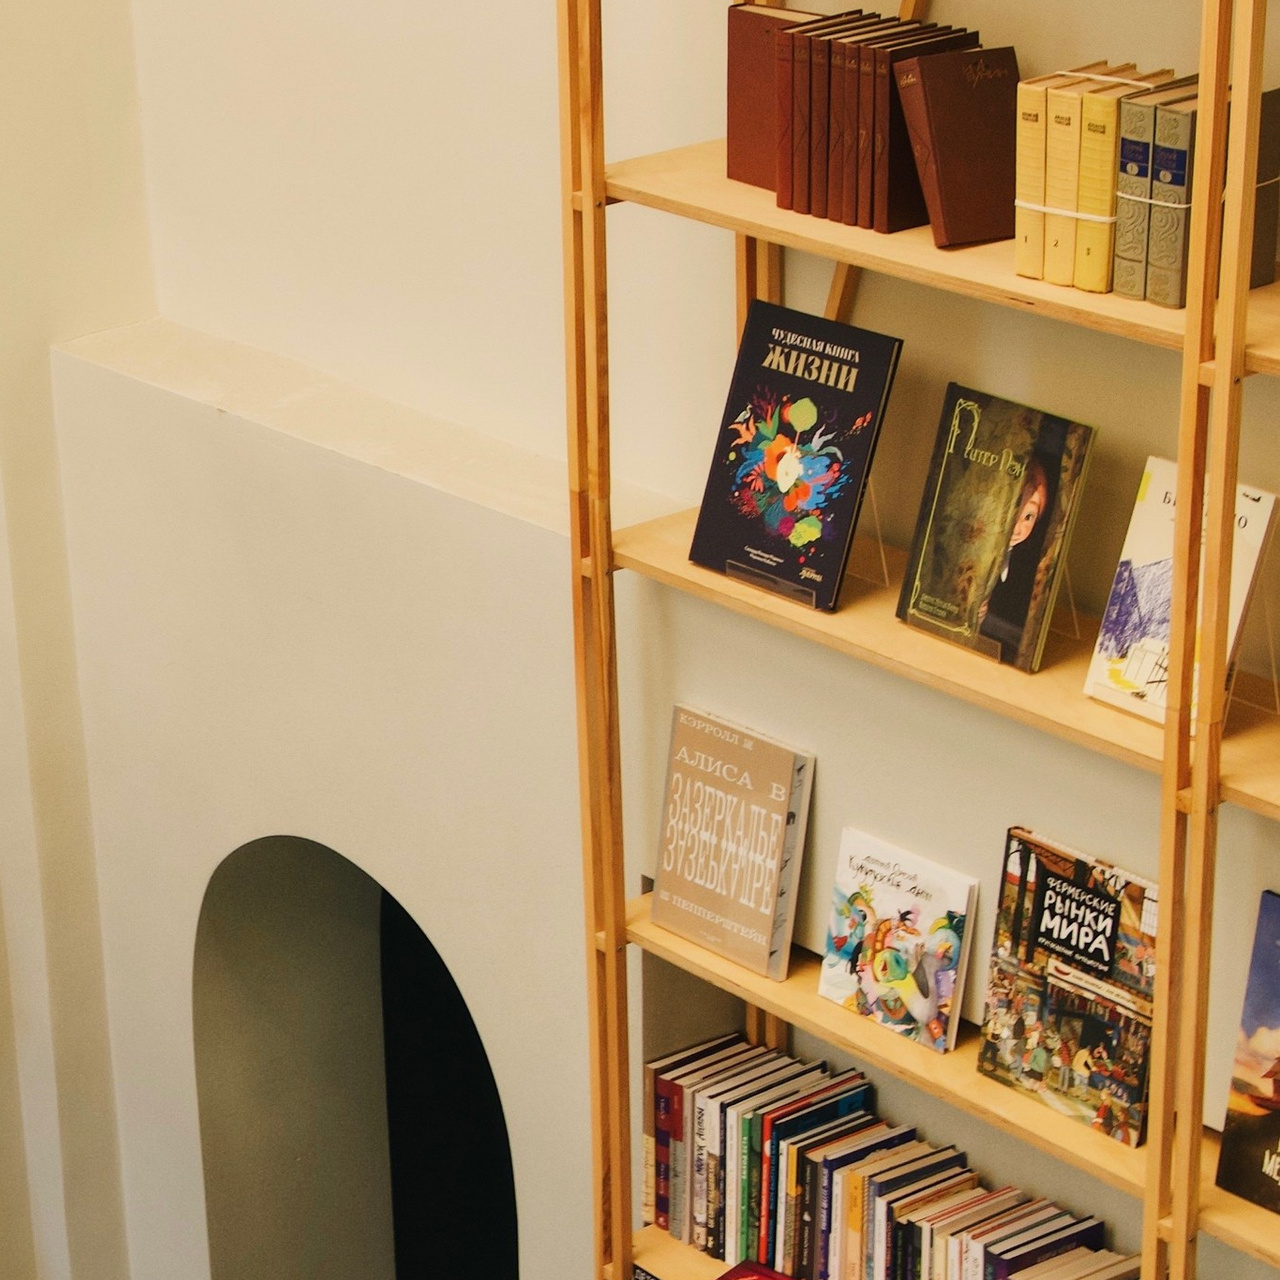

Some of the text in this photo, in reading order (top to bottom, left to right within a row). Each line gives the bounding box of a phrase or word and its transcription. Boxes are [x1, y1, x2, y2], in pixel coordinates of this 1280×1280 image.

[772, 328, 860, 363] ЧУДЕСНАЯ КНИГА
[761, 343, 860, 393] ЖИЗНИ
[679, 713, 739, 745] КЭРРОЛЛ
[675, 746, 754, 790] АЛИСА
[1044, 890, 1113, 938] РЫНКИ
[1047, 877, 1116, 916] ФЕРМЕРСКИЕ
[1040, 909, 1110, 961] МИРА
